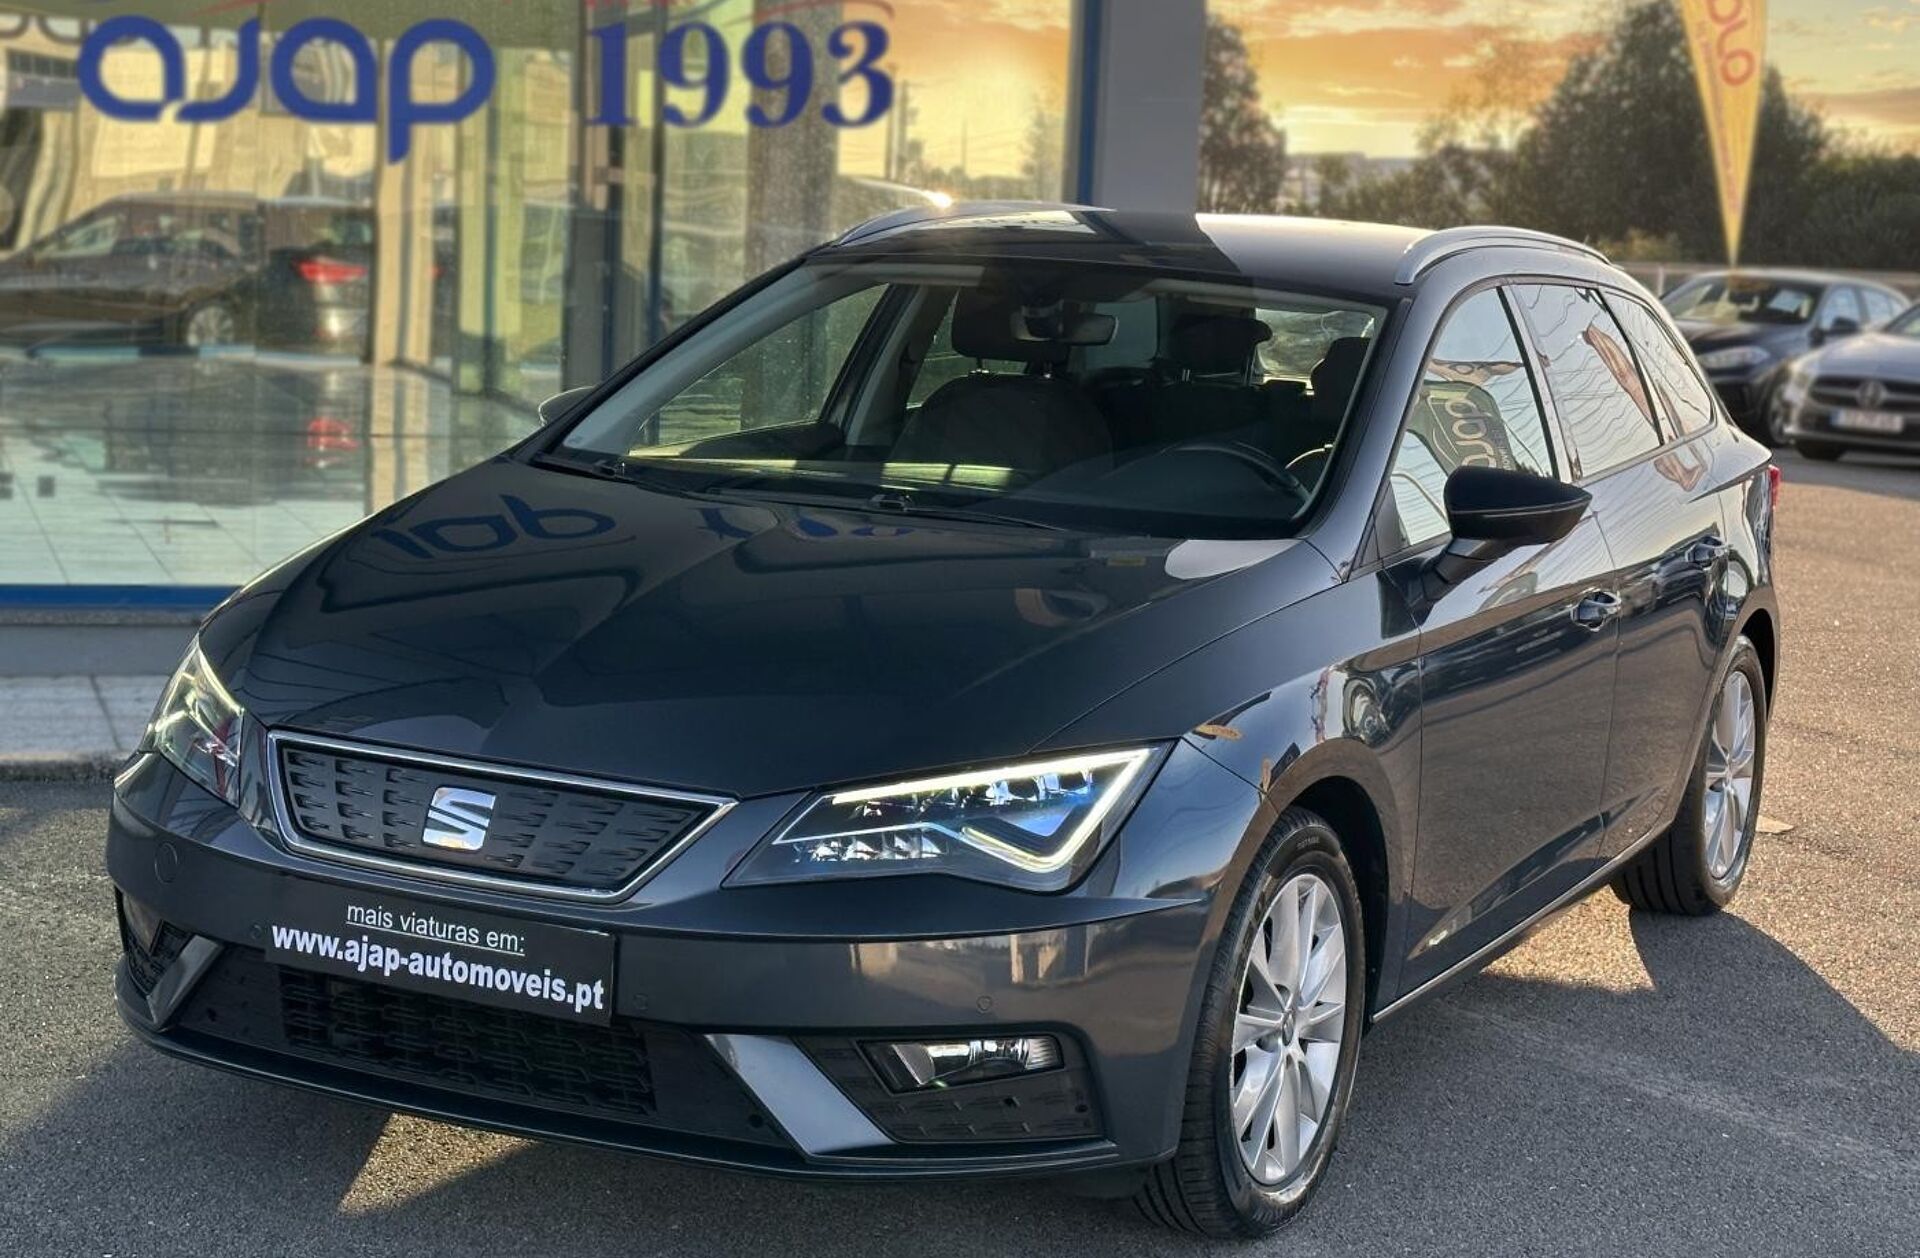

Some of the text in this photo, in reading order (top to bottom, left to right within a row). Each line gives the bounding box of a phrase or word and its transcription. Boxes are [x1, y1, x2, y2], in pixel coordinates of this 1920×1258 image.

[585, 20, 896, 129] 1993
[271, 924, 605, 1013] www.ajap-automoveis.pt
[347, 903, 525, 953] mais viaturas em:
